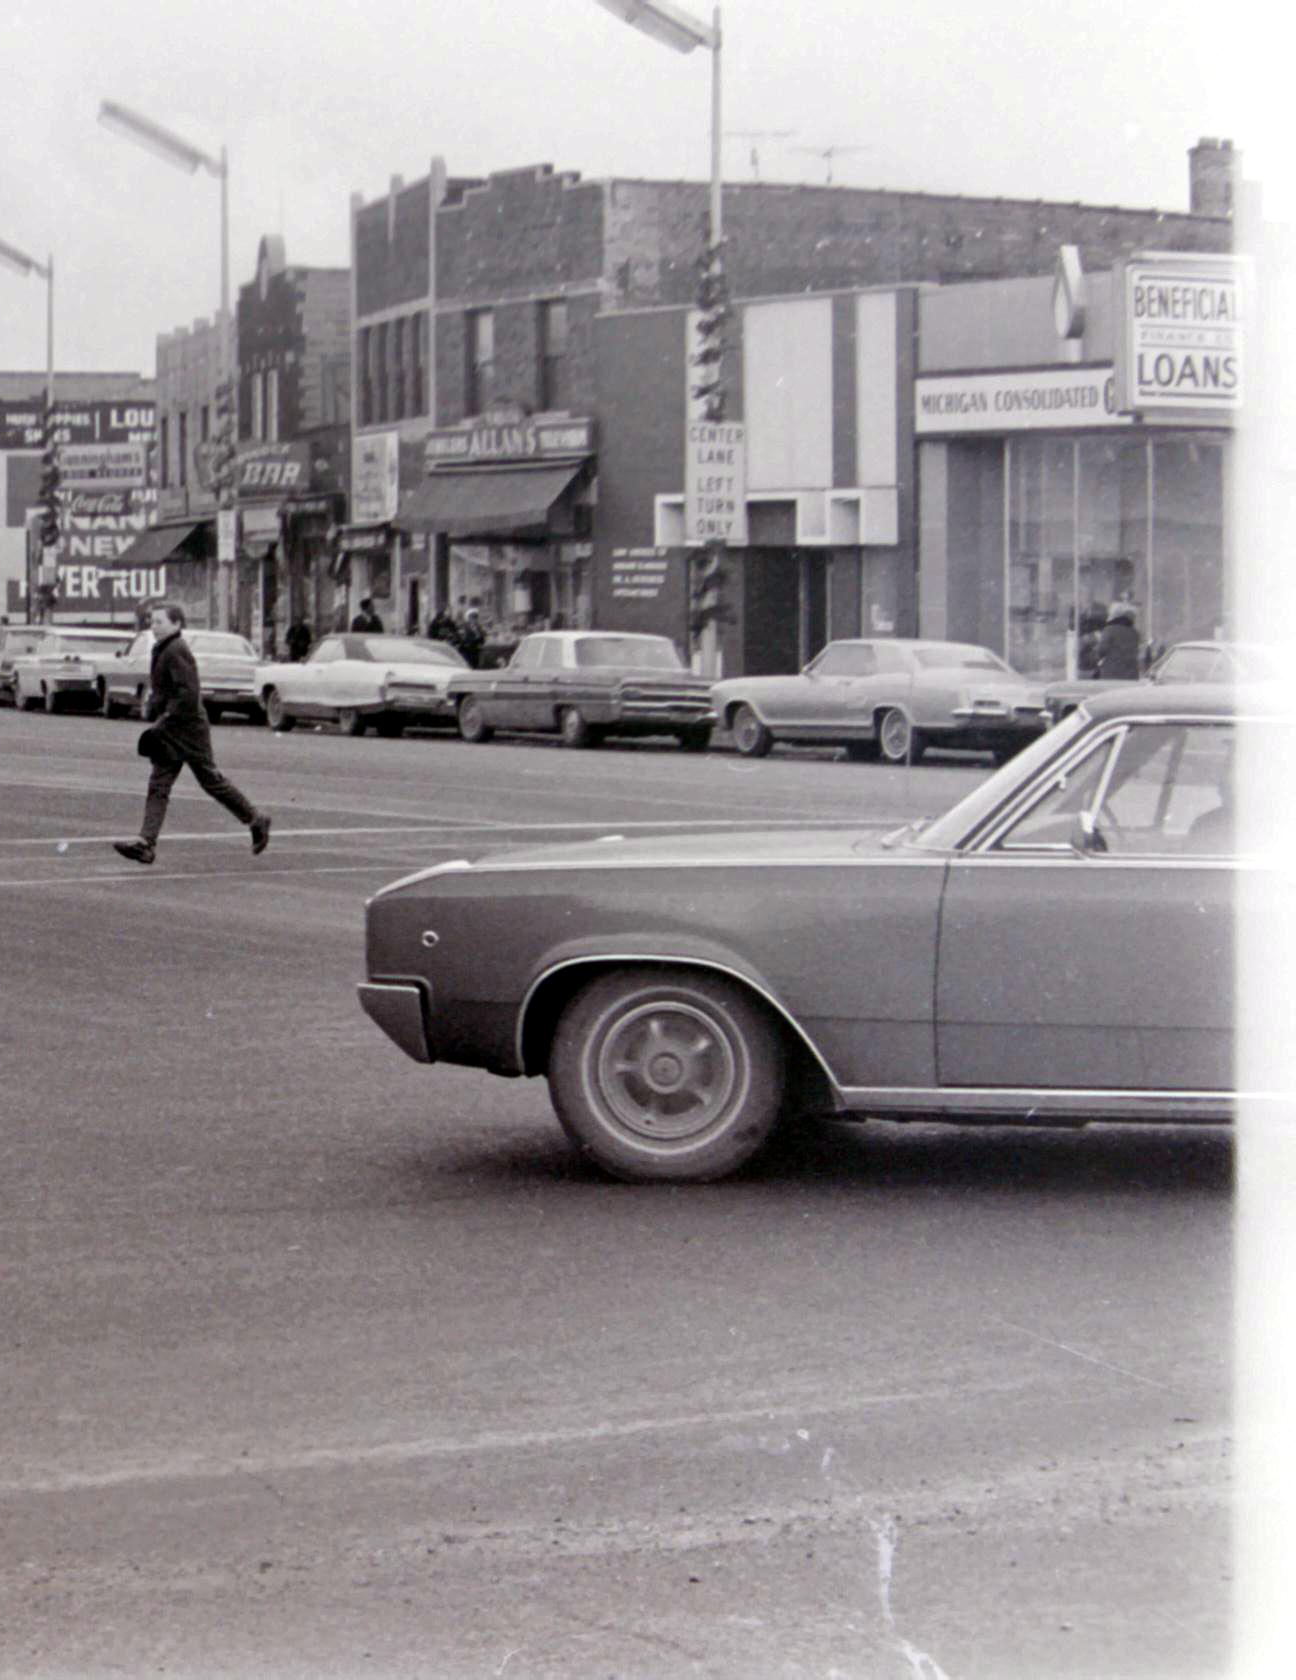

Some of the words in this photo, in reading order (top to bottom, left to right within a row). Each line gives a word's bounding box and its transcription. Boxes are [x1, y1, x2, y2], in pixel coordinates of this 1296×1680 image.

[1136, 352, 1238, 389] LOANS
[920, 391, 988, 415] MICHIGAN
[993, 385, 1099, 413] CONSOLIDATED
[24, 428, 71, 443] SHES
[688, 426, 744, 444] CENTER
[697, 448, 735, 465] LANE
[242, 461, 302, 486] BAR
[697, 476, 734, 494] LEFT
[697, 497, 735, 515] TURN
[696, 518, 733, 536] ONLY
